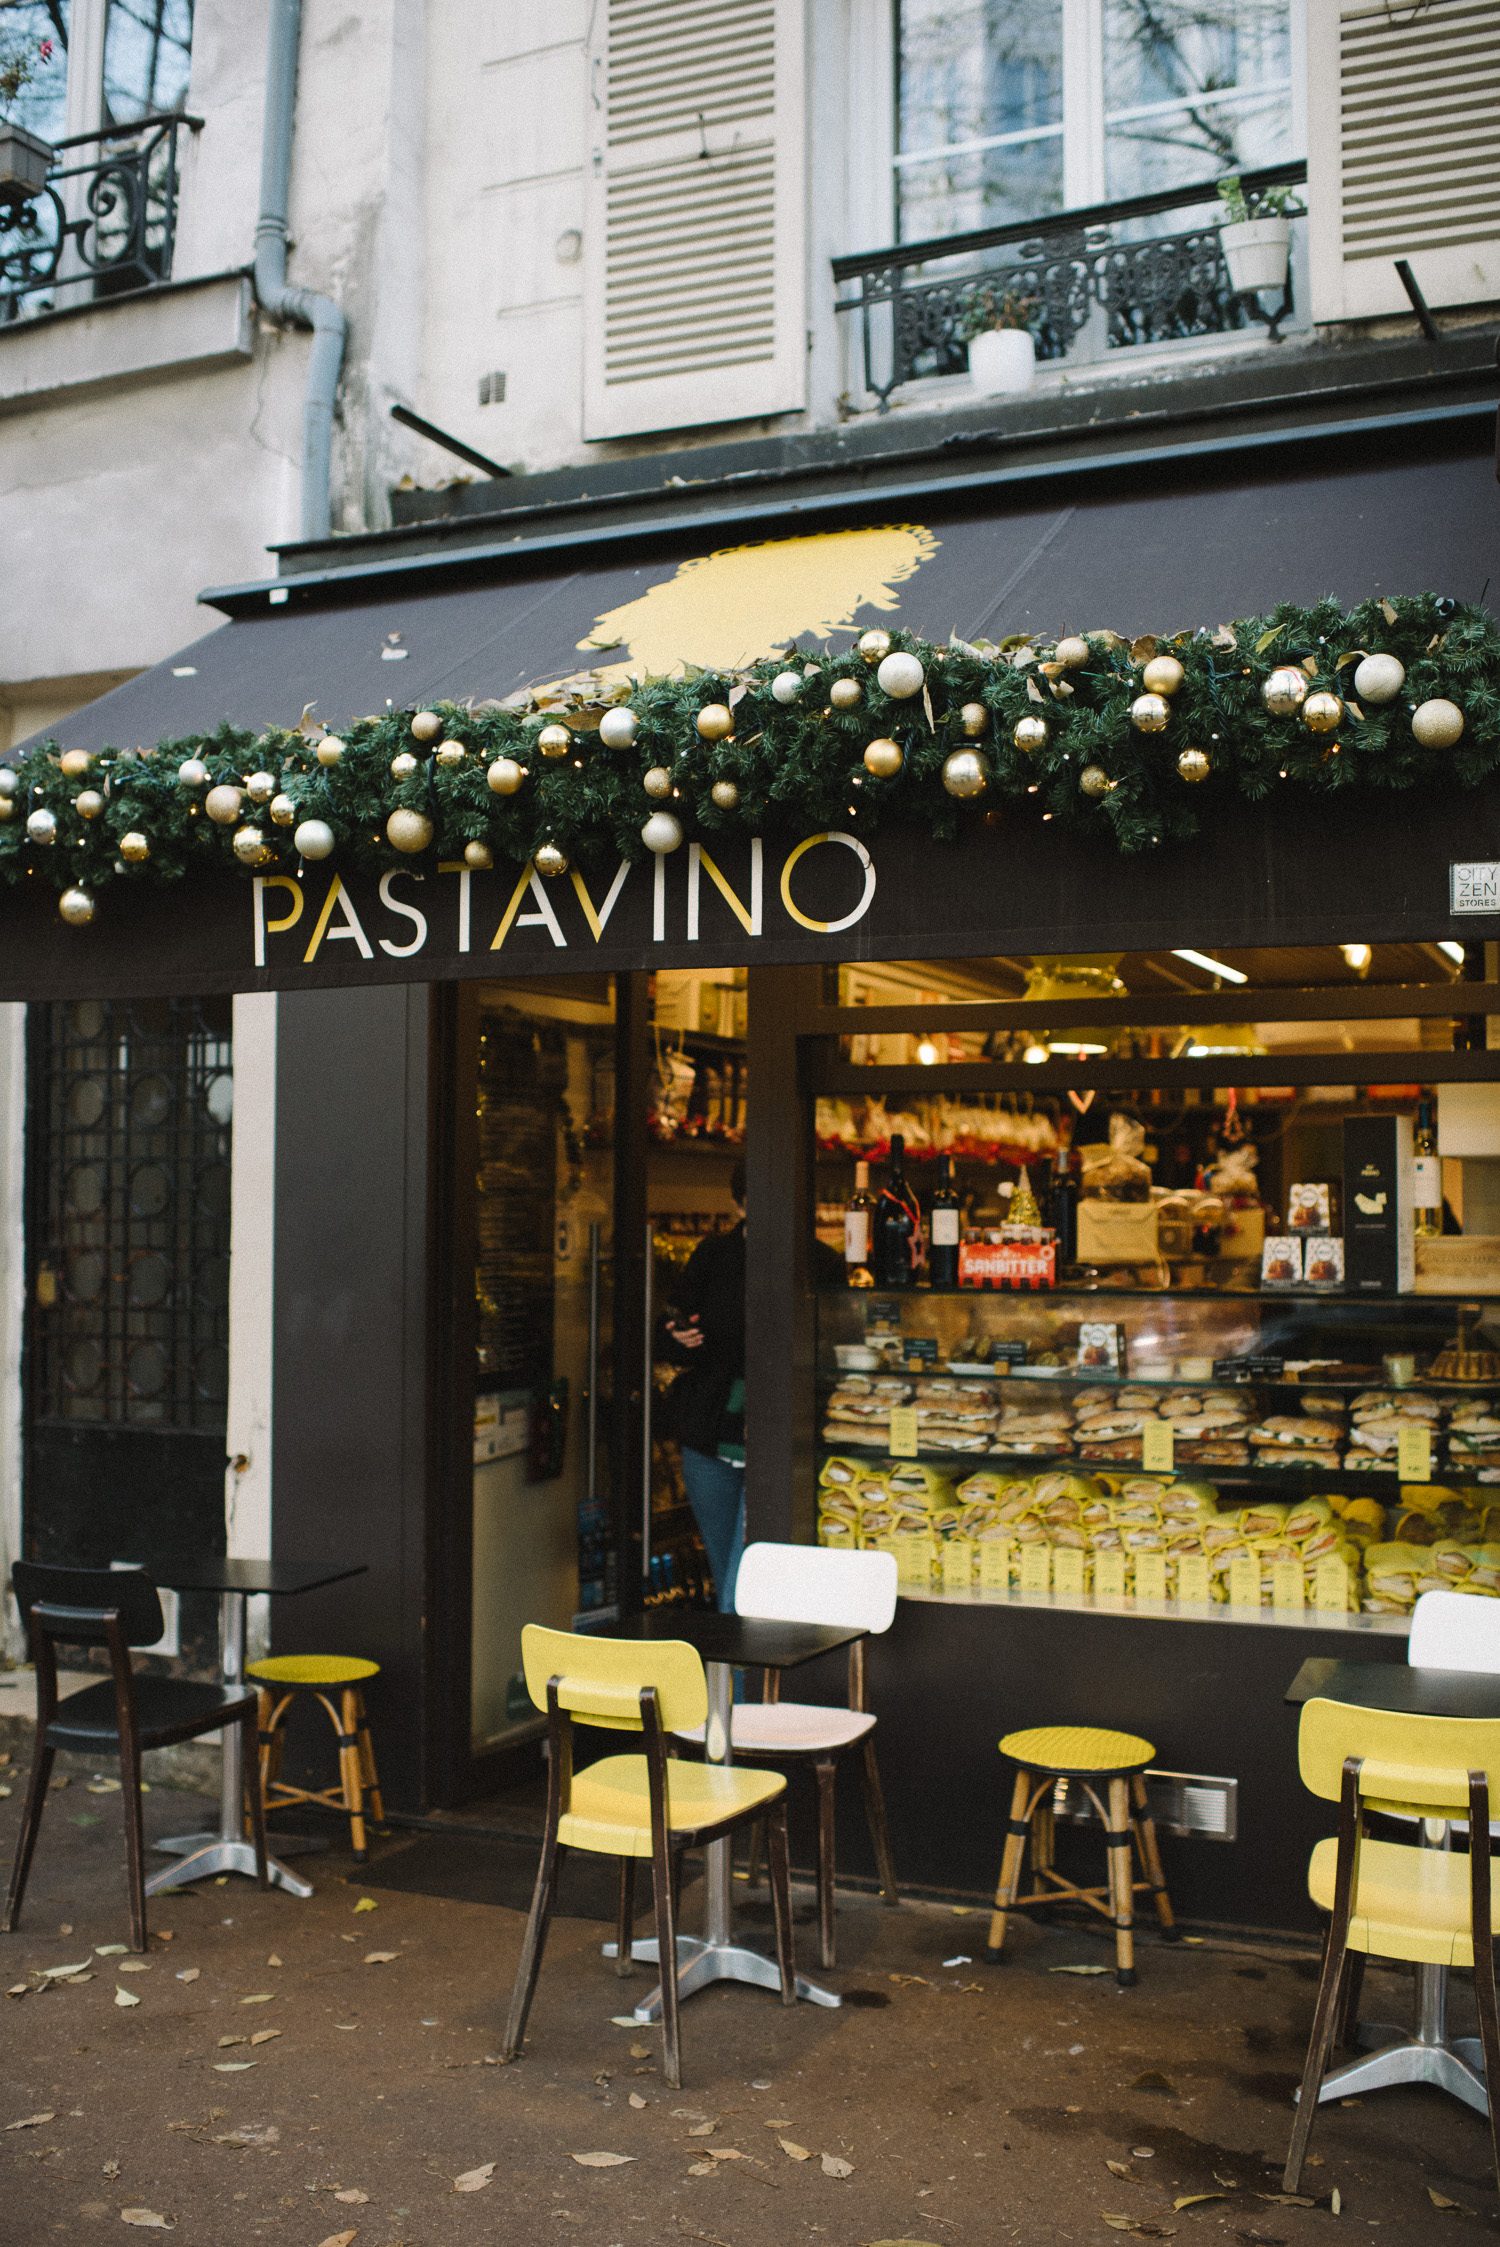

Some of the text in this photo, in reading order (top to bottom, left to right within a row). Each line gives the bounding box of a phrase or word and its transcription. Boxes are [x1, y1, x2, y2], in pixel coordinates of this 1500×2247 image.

[1459, 882, 1496, 896] ZEN
[253, 831, 876, 967] PASTAVINO
[1459, 899, 1496, 907] STORES
[964, 1258, 1048, 1275] SANBITTER
